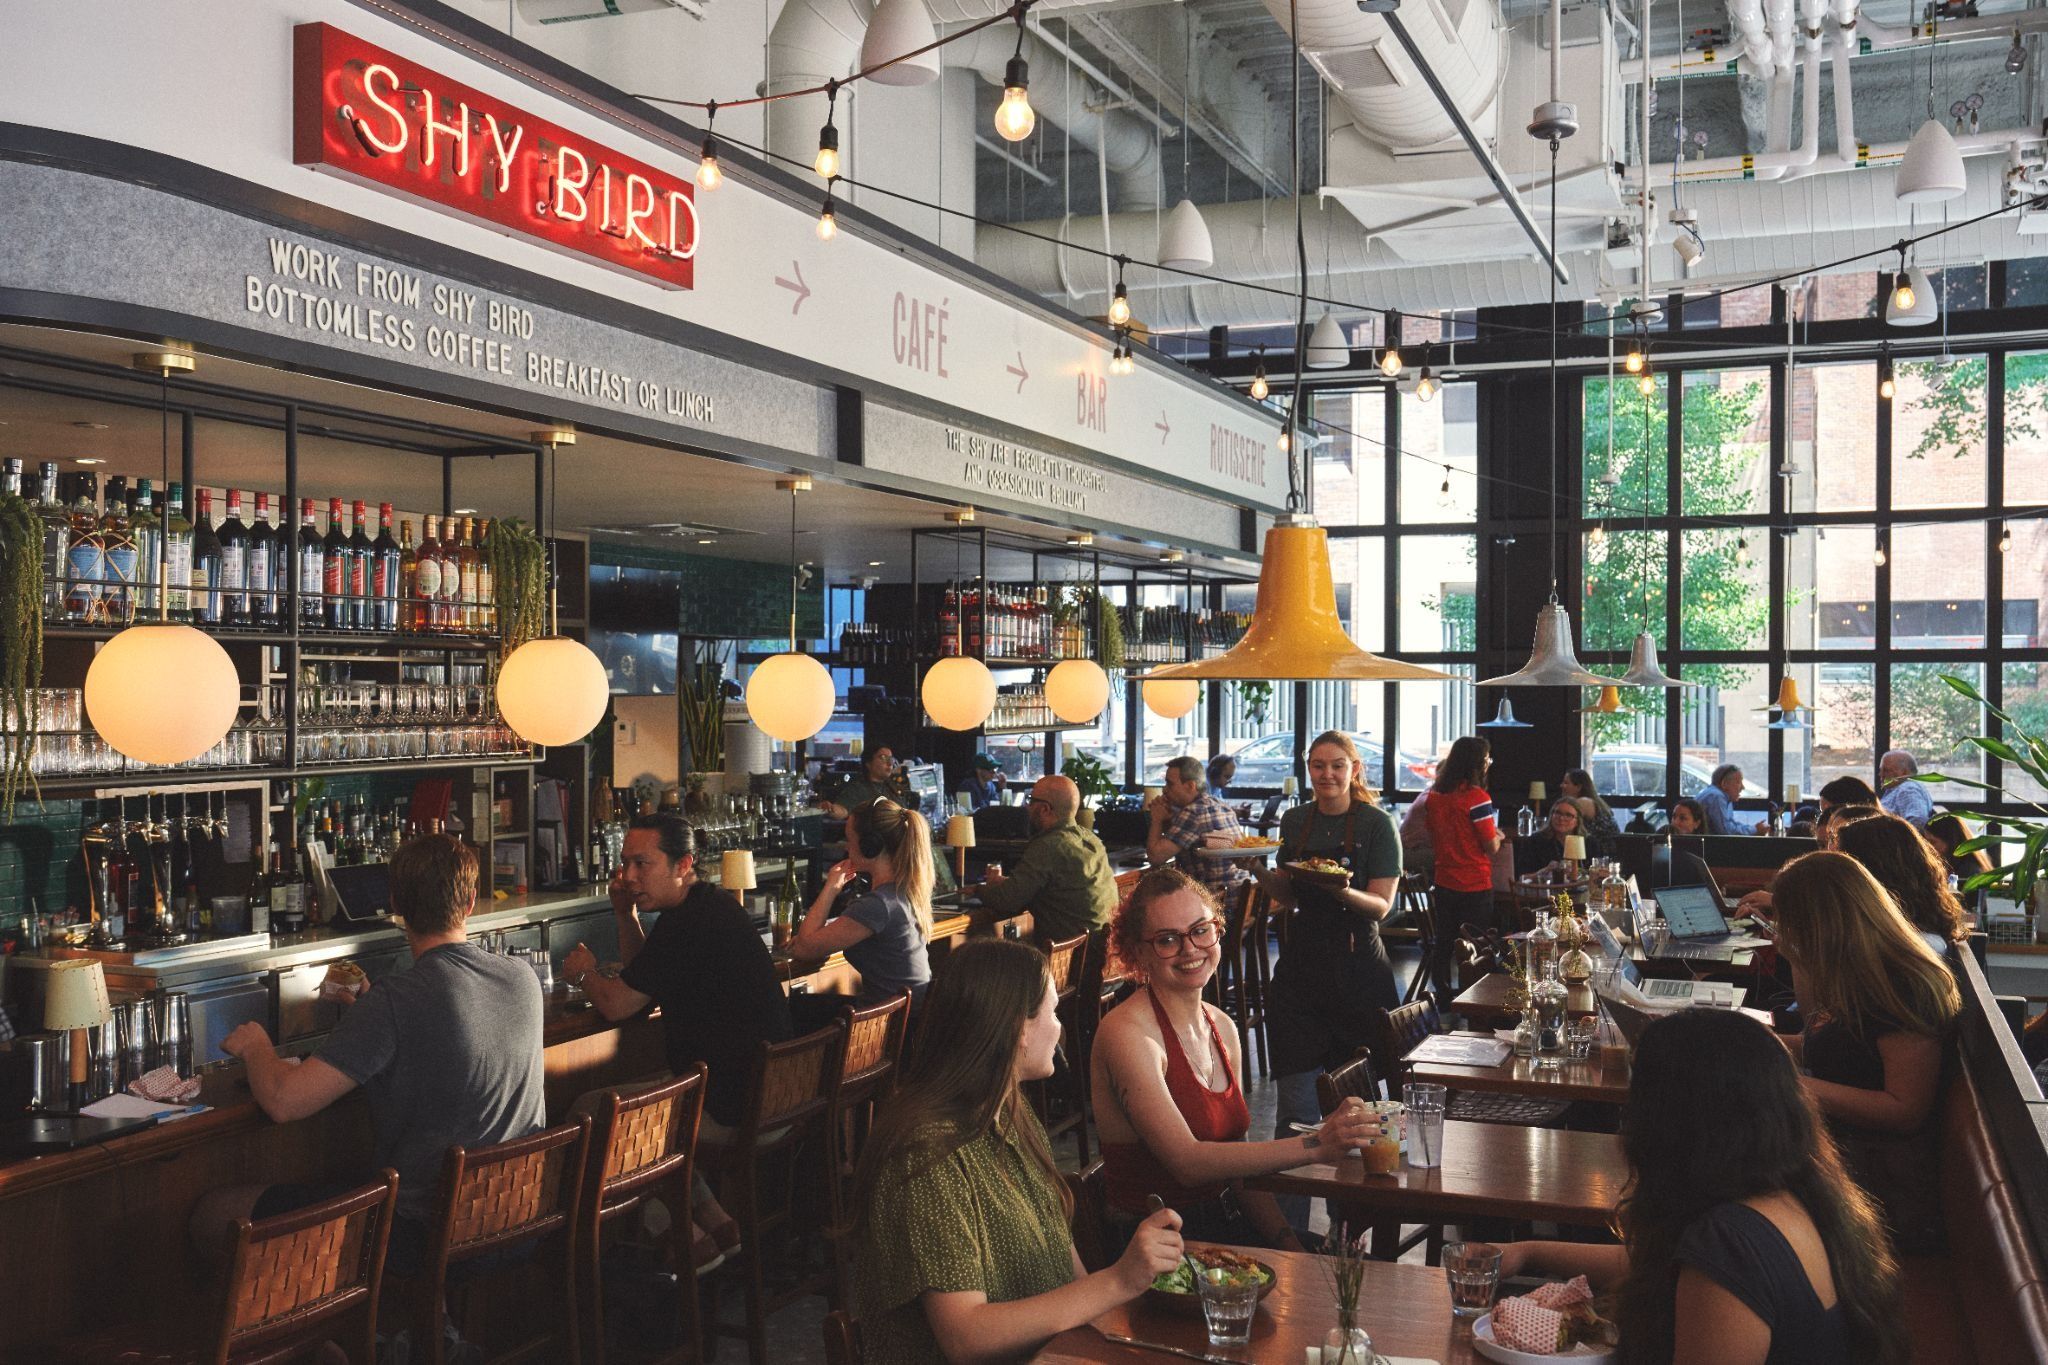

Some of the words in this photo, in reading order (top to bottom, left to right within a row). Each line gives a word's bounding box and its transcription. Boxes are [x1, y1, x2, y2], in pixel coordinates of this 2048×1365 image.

[357, 64, 523, 192] SHY
[552, 145, 701, 260] BIRD
[245, 275, 417, 352] BOTTOMLESS
[426, 325, 513, 376] COFFEE
[527, 351, 632, 405] BREAKFAST
[638, 381, 659, 412] OR
[665, 387, 714, 423] LUNCH
[269, 237, 343, 291] WORK
[356, 262, 420, 310] FROM
[432, 283, 477, 325] SHY
[488, 300, 534, 341] BIRD
[893, 290, 949, 379] CAFÉ
[1077, 371, 1107, 434] BAR
[1209, 423, 1266, 488] ROTISSERIE
[945, 428, 966, 454] THE
[969, 436, 988, 460] SHY
[990, 443, 1009, 466] ARE
[1013, 449, 1063, 481] FREQUENTLY
[1064, 463, 1108, 494] THOUGHTFUL
[964, 462, 984, 486] AND
[987, 469, 1046, 500] OCCASIONALLY
[1050, 484, 1087, 511] BRILLIANT
